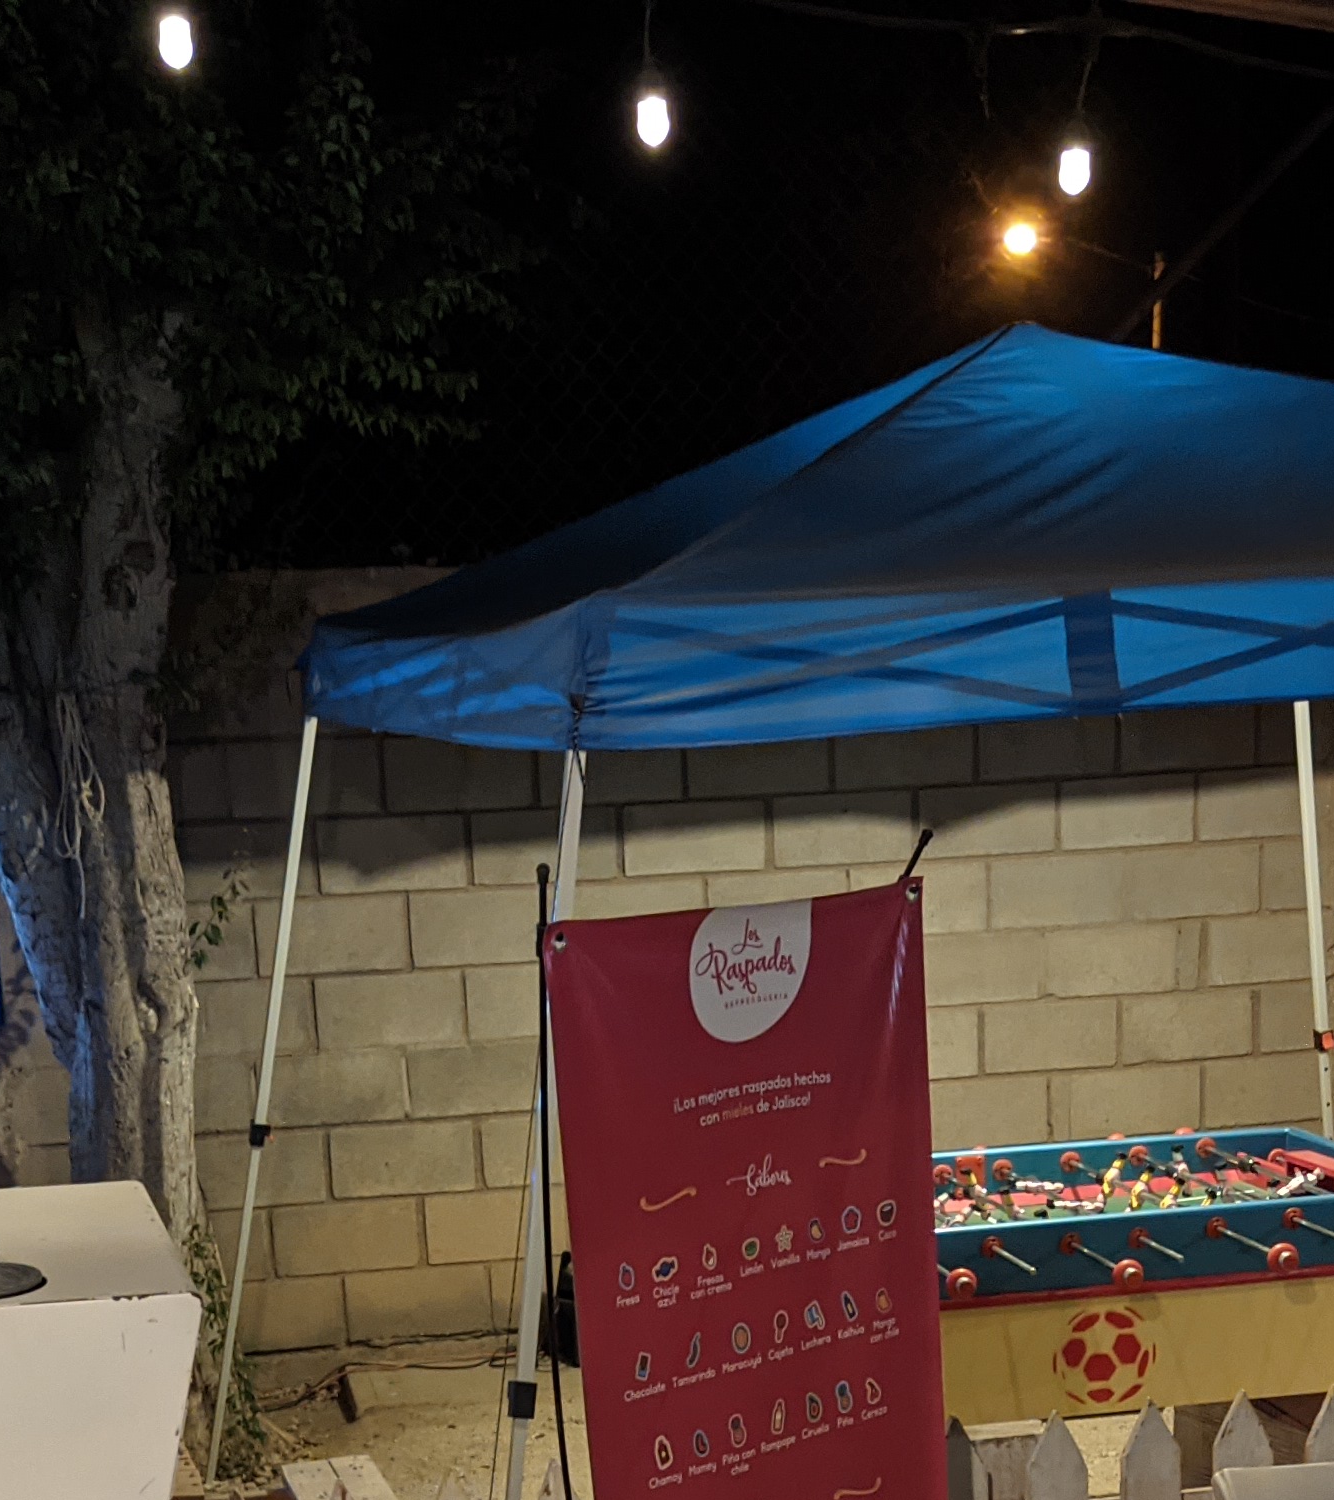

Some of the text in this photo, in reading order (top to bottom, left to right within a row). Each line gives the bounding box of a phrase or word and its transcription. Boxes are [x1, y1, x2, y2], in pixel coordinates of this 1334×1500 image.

[695, 936, 796, 995] Raspados
[698, 1086, 740, 1107] mejores
[742, 1075, 792, 1096] raspados
[794, 1071, 831, 1087] hechos
[700, 1092, 811, 1127] con mieles de Jalisco!
[624, 1382, 666, 1402] Chocolate
[672, 1367, 716, 1388] Tamarindo
